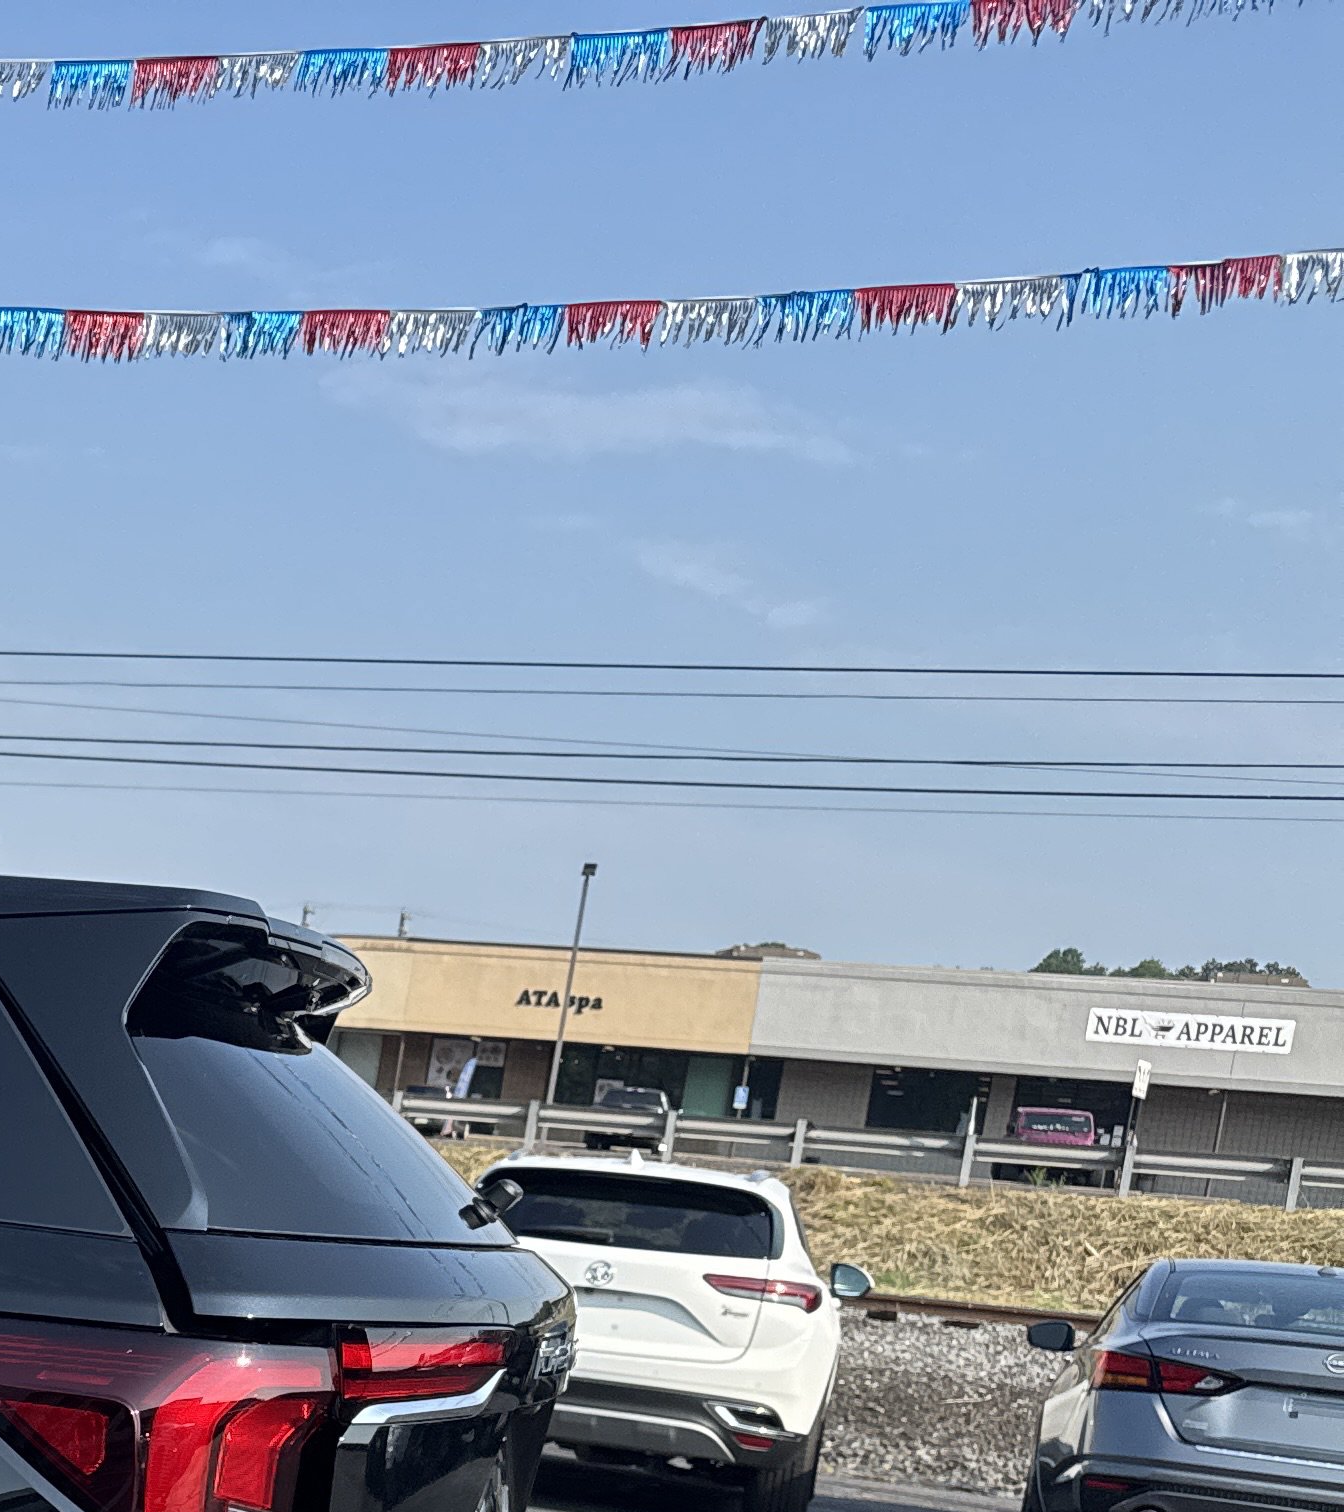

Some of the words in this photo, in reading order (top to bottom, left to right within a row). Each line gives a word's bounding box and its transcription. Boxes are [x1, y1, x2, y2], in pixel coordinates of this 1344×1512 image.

[515, 988, 560, 1008] ATA
[567, 995, 603, 1015] spa
[1093, 1015, 1143, 1038] NBL
[1176, 1021, 1287, 1047] APPAREL
